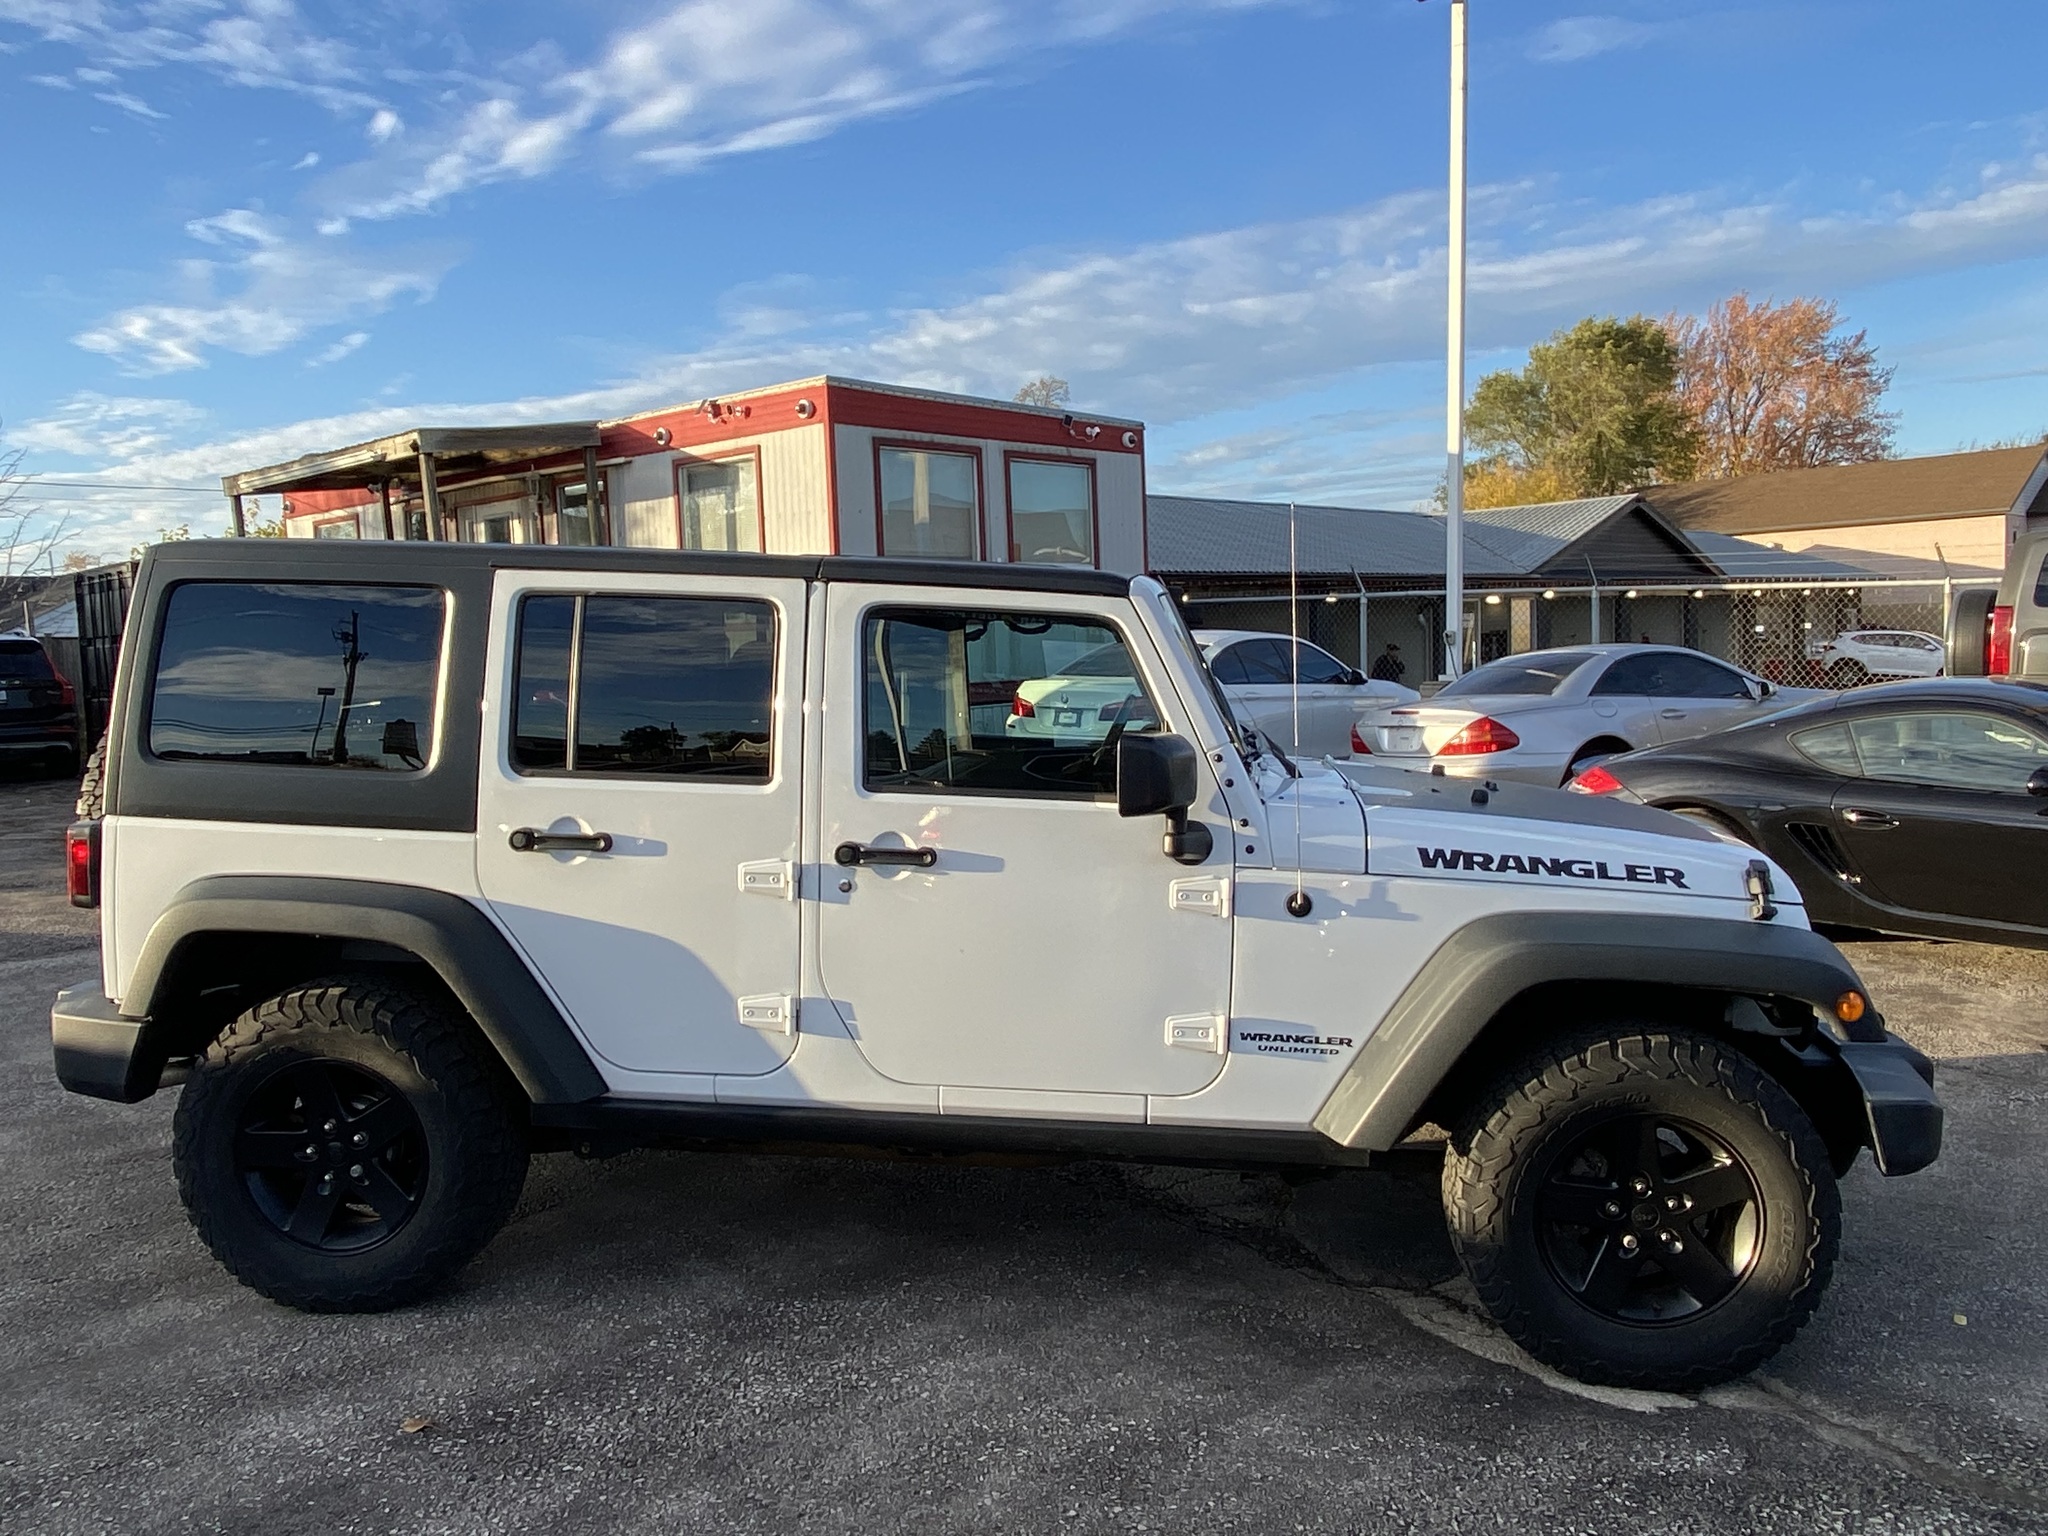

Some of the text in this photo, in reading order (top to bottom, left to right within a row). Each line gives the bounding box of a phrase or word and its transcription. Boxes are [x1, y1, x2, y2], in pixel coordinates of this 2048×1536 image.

[1416, 847, 1691, 889] WRANGLER
[1240, 1032, 1353, 1047] WRANGLER
[1257, 1045, 1340, 1055] UNLIMITED
